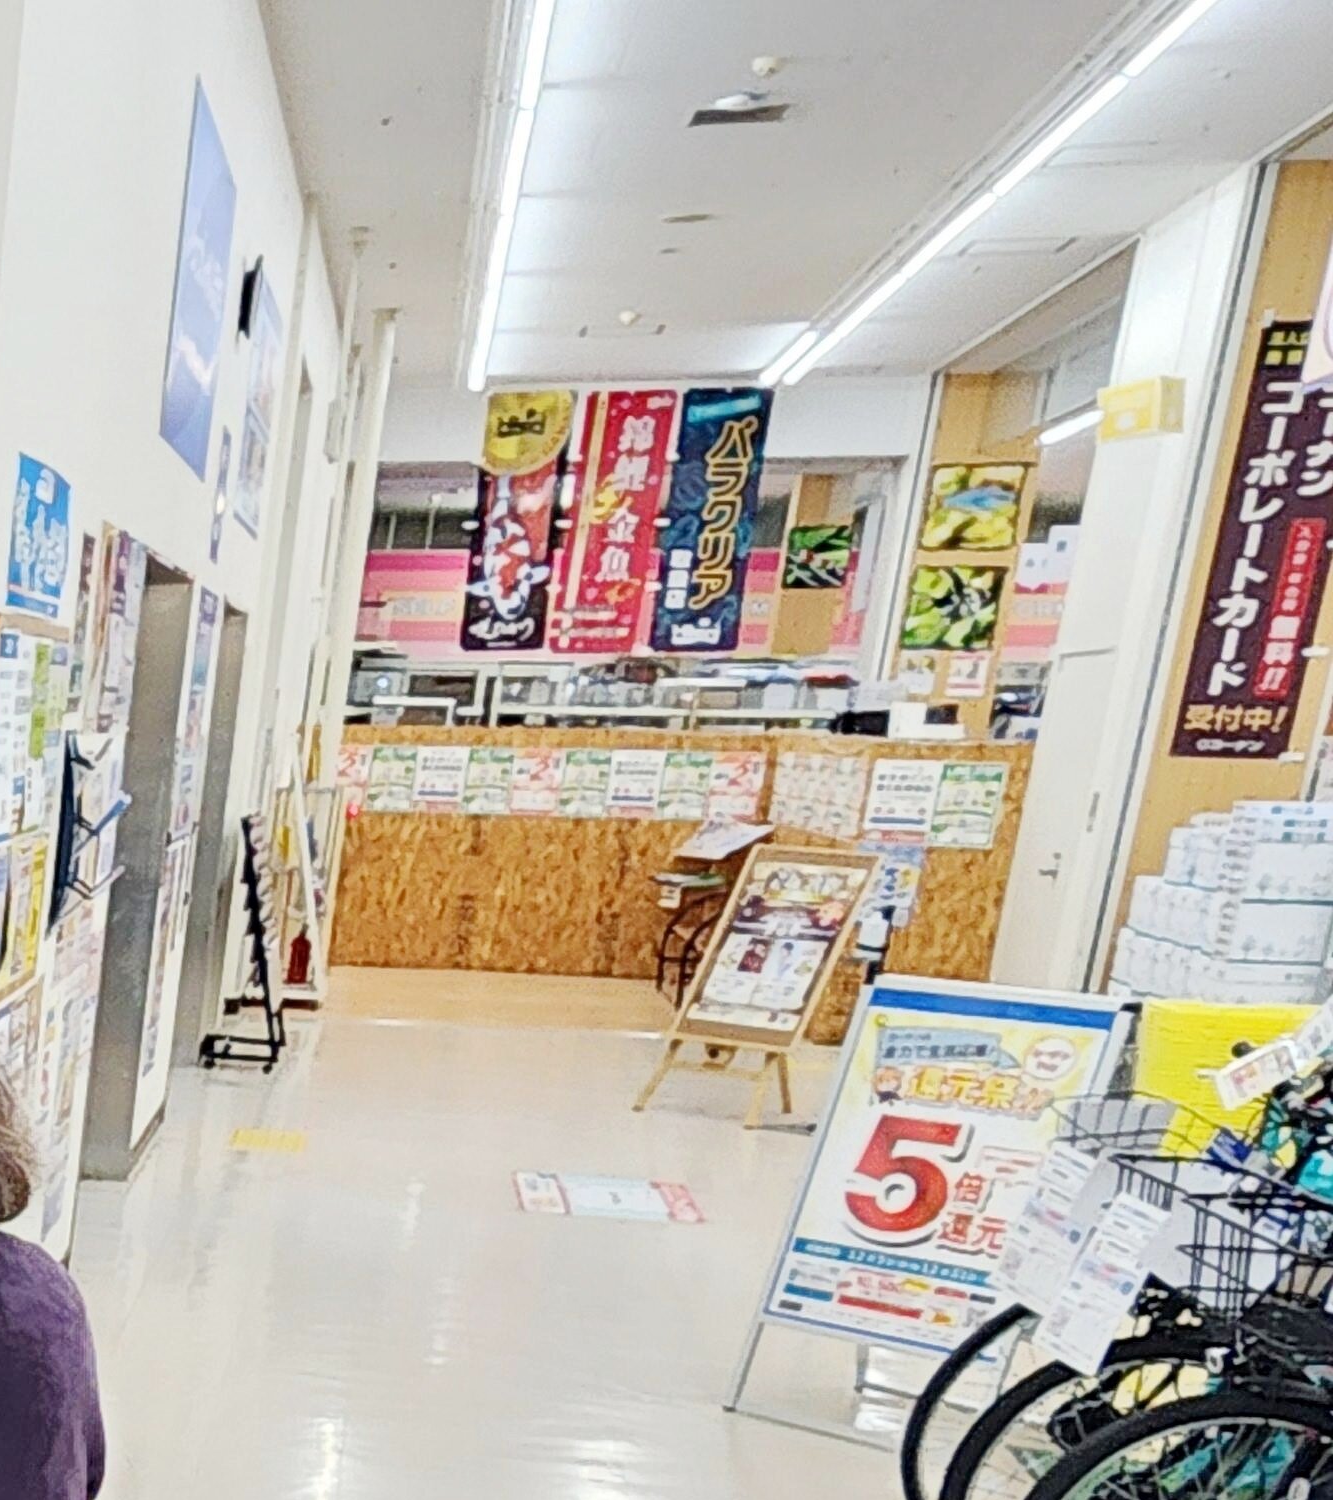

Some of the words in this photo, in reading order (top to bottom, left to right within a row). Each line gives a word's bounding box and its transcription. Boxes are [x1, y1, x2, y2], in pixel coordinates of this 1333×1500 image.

[1207, 381, 1305, 696] コーポレートカード
[1184, 703, 1288, 733] 受付中!
[844, 1114, 962, 1232] 5
